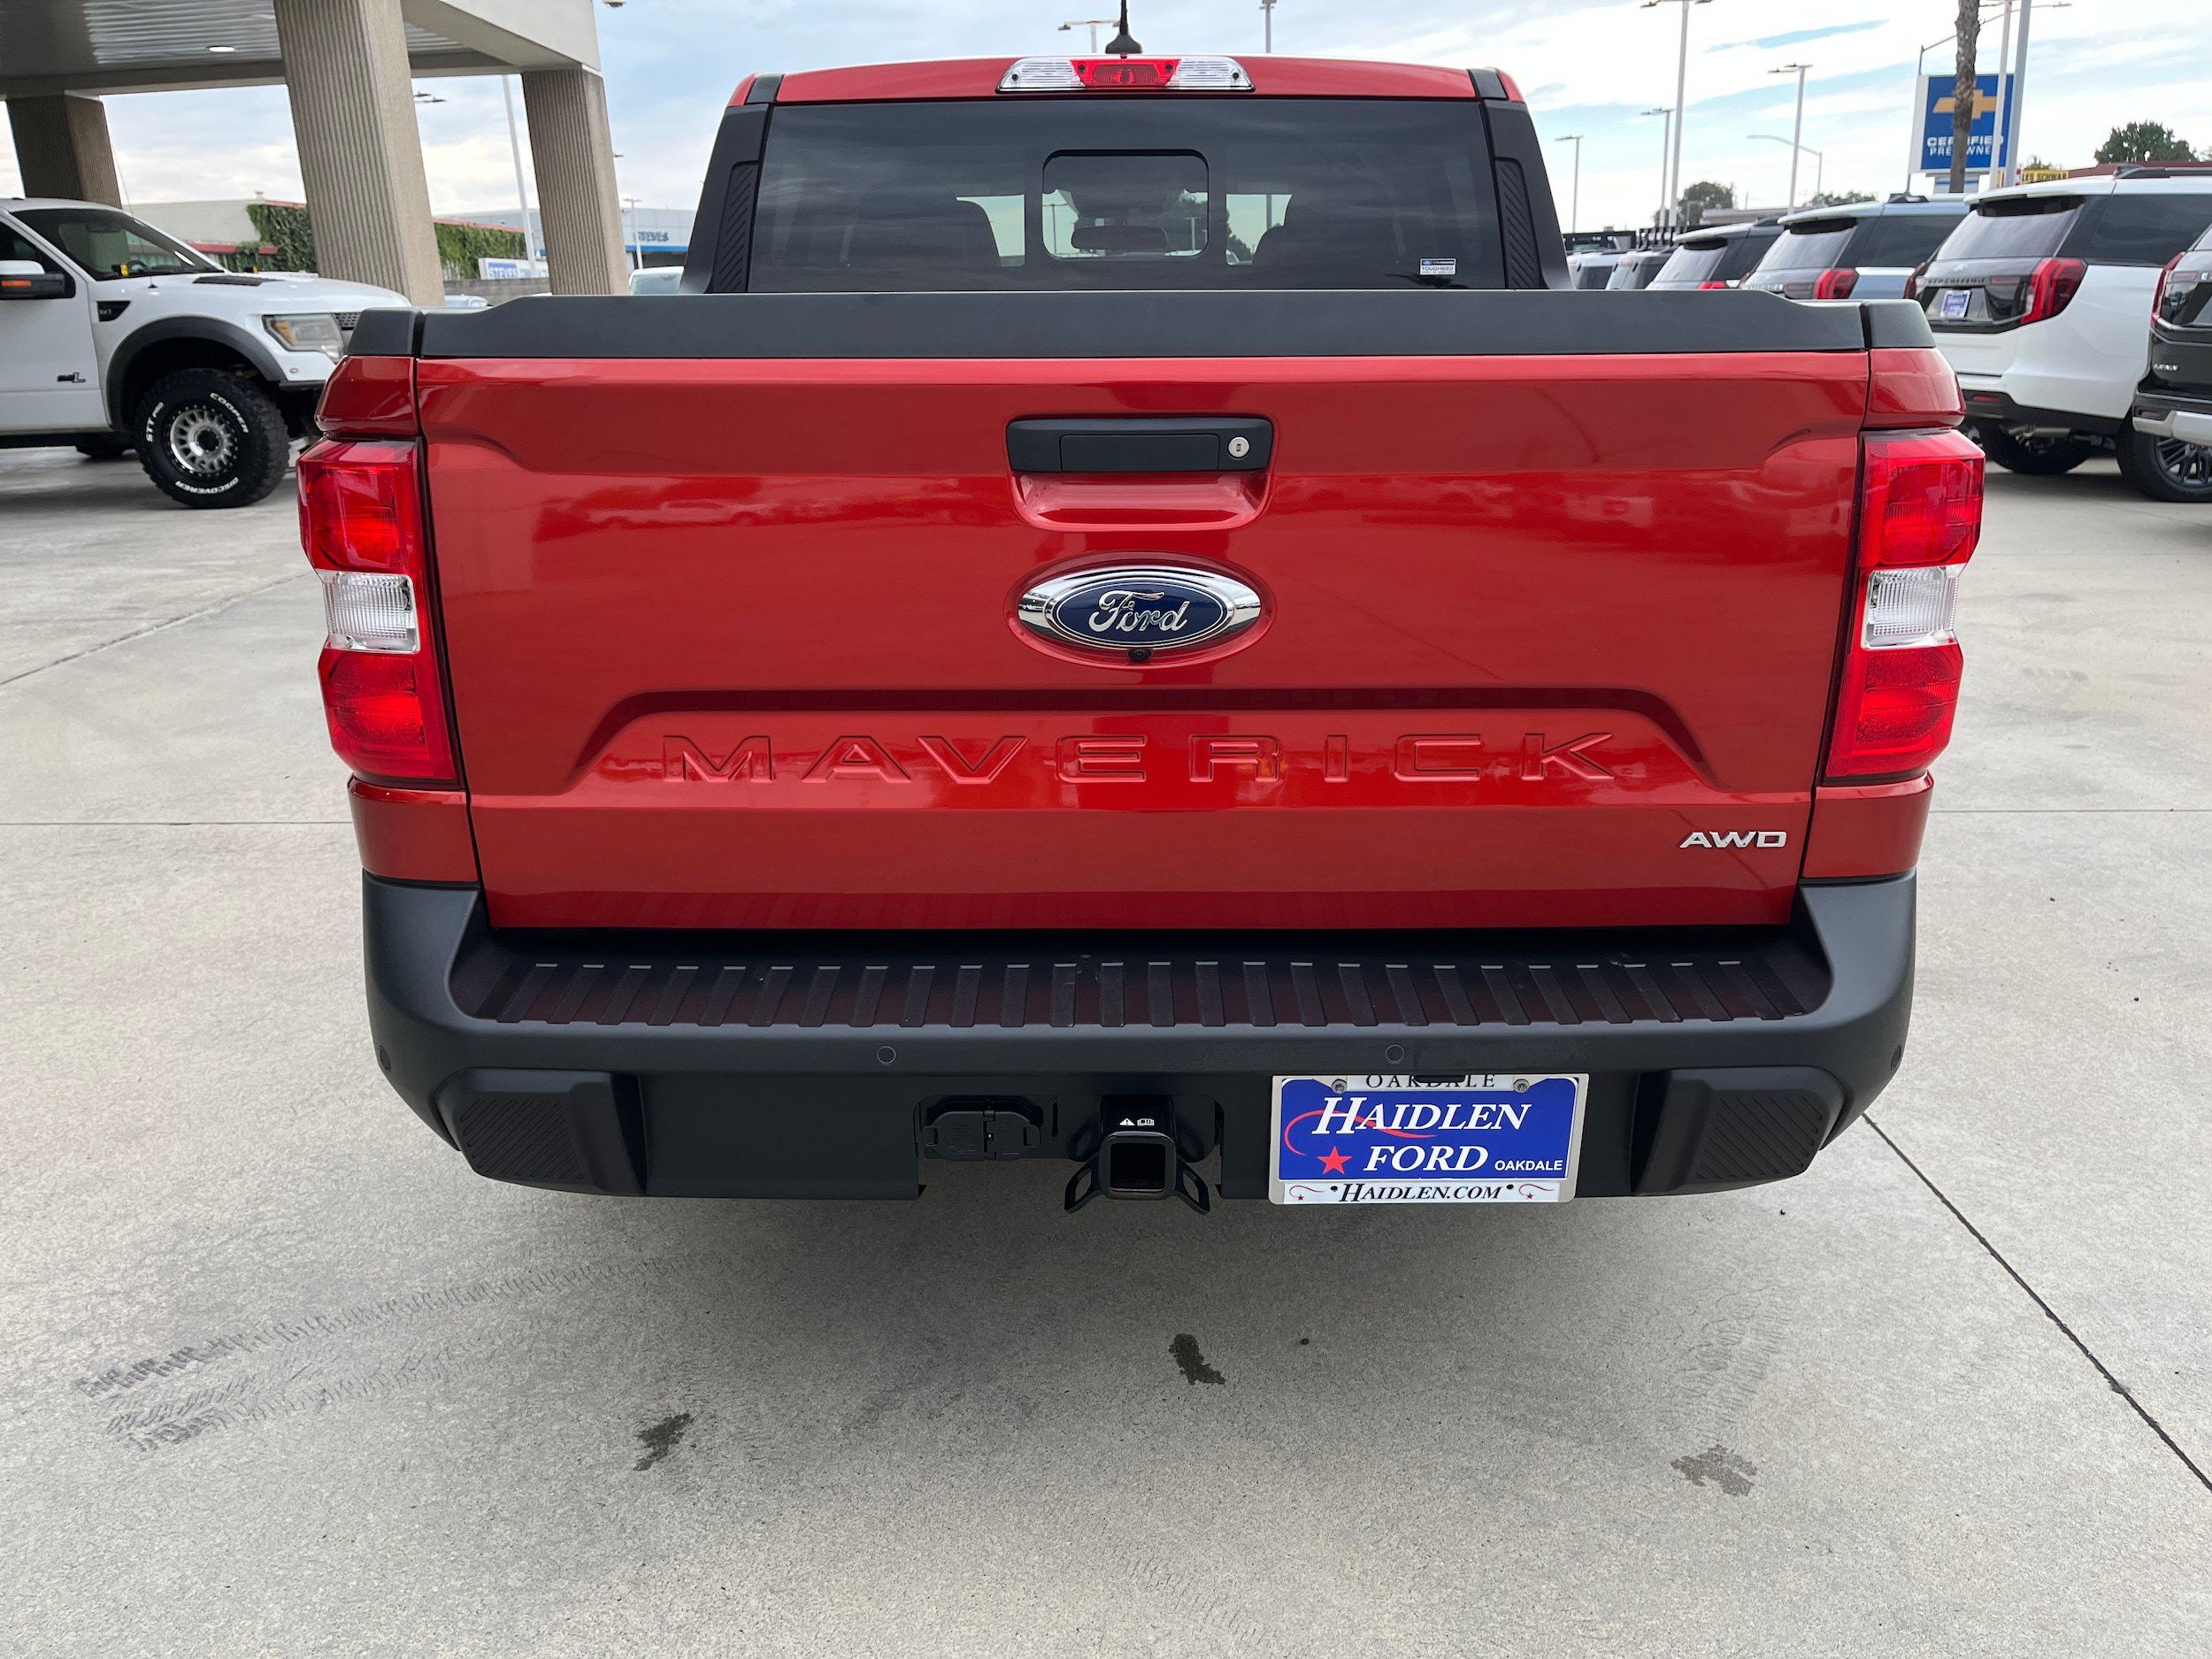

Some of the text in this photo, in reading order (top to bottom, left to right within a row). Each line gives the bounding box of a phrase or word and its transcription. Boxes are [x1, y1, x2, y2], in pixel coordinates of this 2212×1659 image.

[1927, 134, 2004, 147] CERIFIE
[210, 392, 250, 434] COOPER
[174, 476, 239, 495] DISCOVERER
[1088, 589, 1190, 633] Ford
[662, 733, 1616, 786] MAVERICK
[1678, 830, 1787, 849] AWD
[1310, 1096, 1532, 1135] HAIDLEN
[1363, 1145, 1563, 1172] FORD OAKDALE
[1338, 1182, 1503, 1203] HAIDLEN.COM
